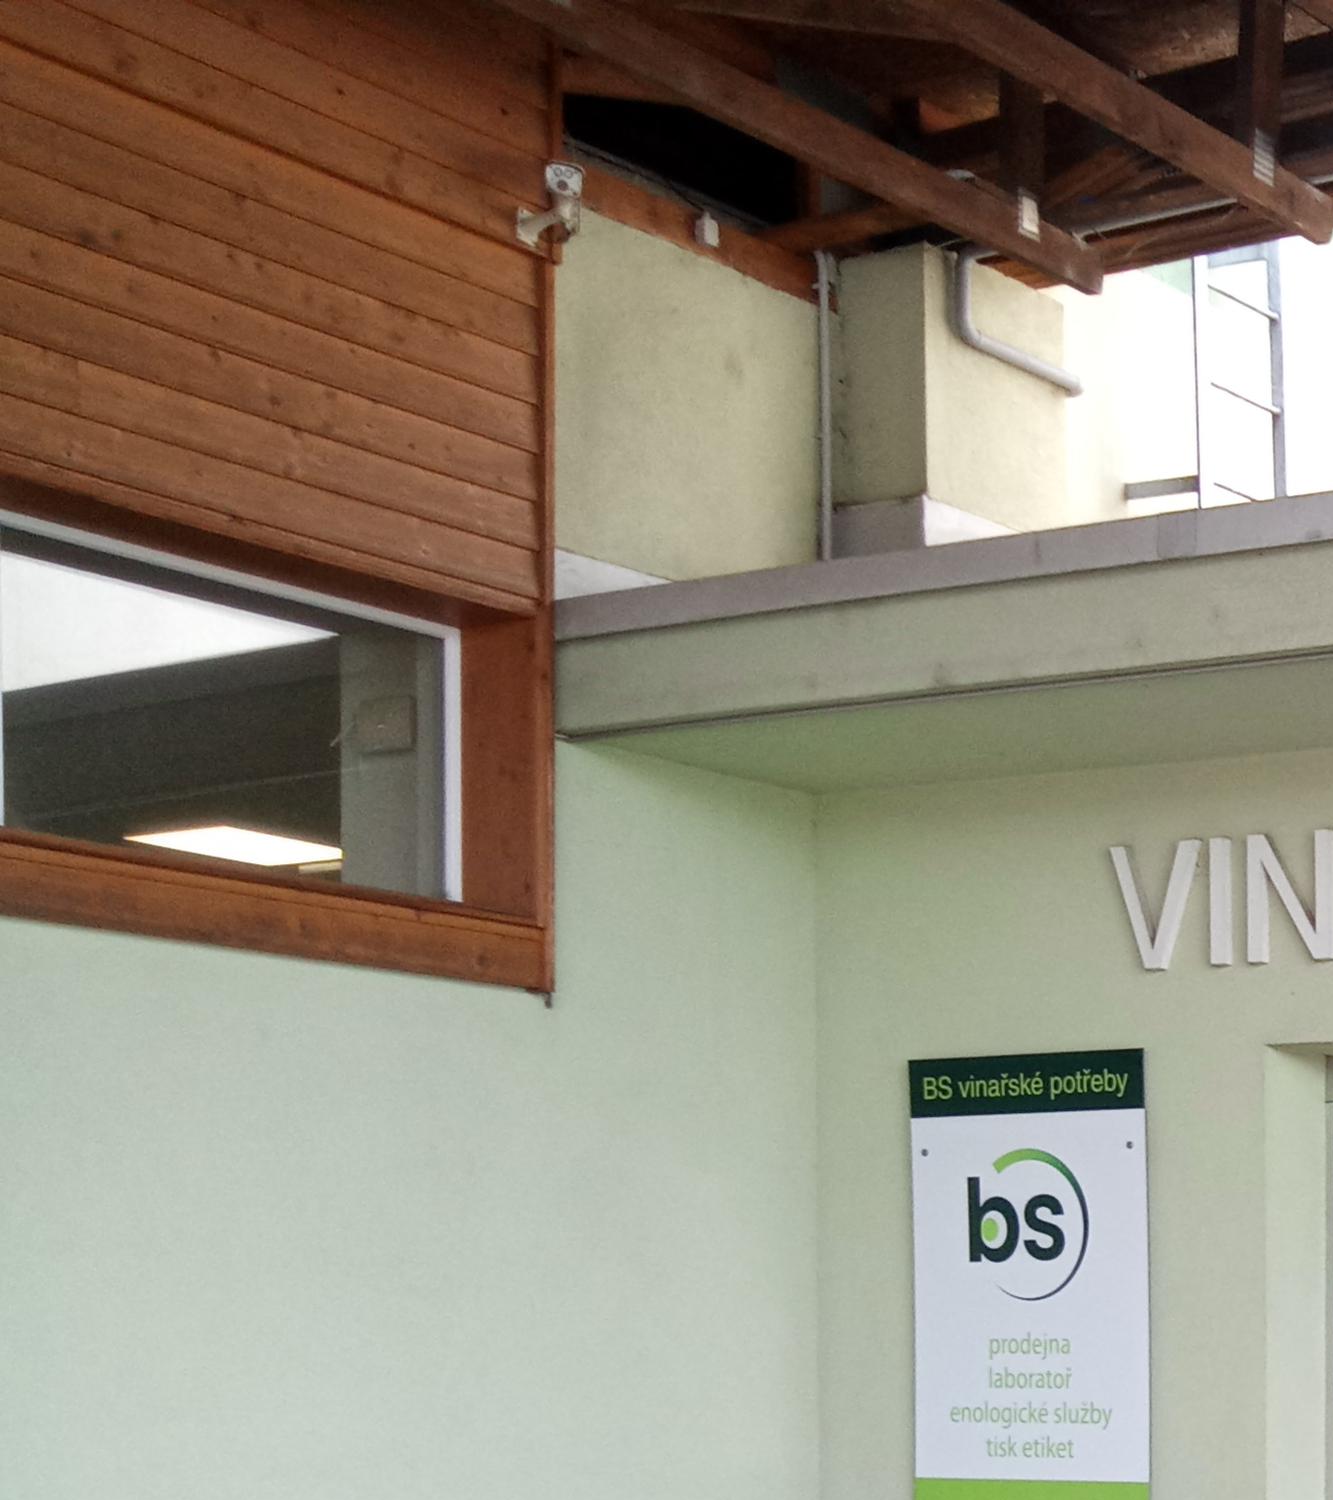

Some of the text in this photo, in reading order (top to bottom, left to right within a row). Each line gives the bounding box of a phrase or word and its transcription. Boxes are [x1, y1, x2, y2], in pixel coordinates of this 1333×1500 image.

[922, 1068, 1129, 1101] BS vinařské potřeby
[967, 1176, 1066, 1263] bs
[988, 1332, 1071, 1359] prodejna
[988, 1367, 1072, 1389] laboratoř
[950, 1401, 1112, 1430] enologické služby
[986, 1436, 1075, 1458] tisk etiket
